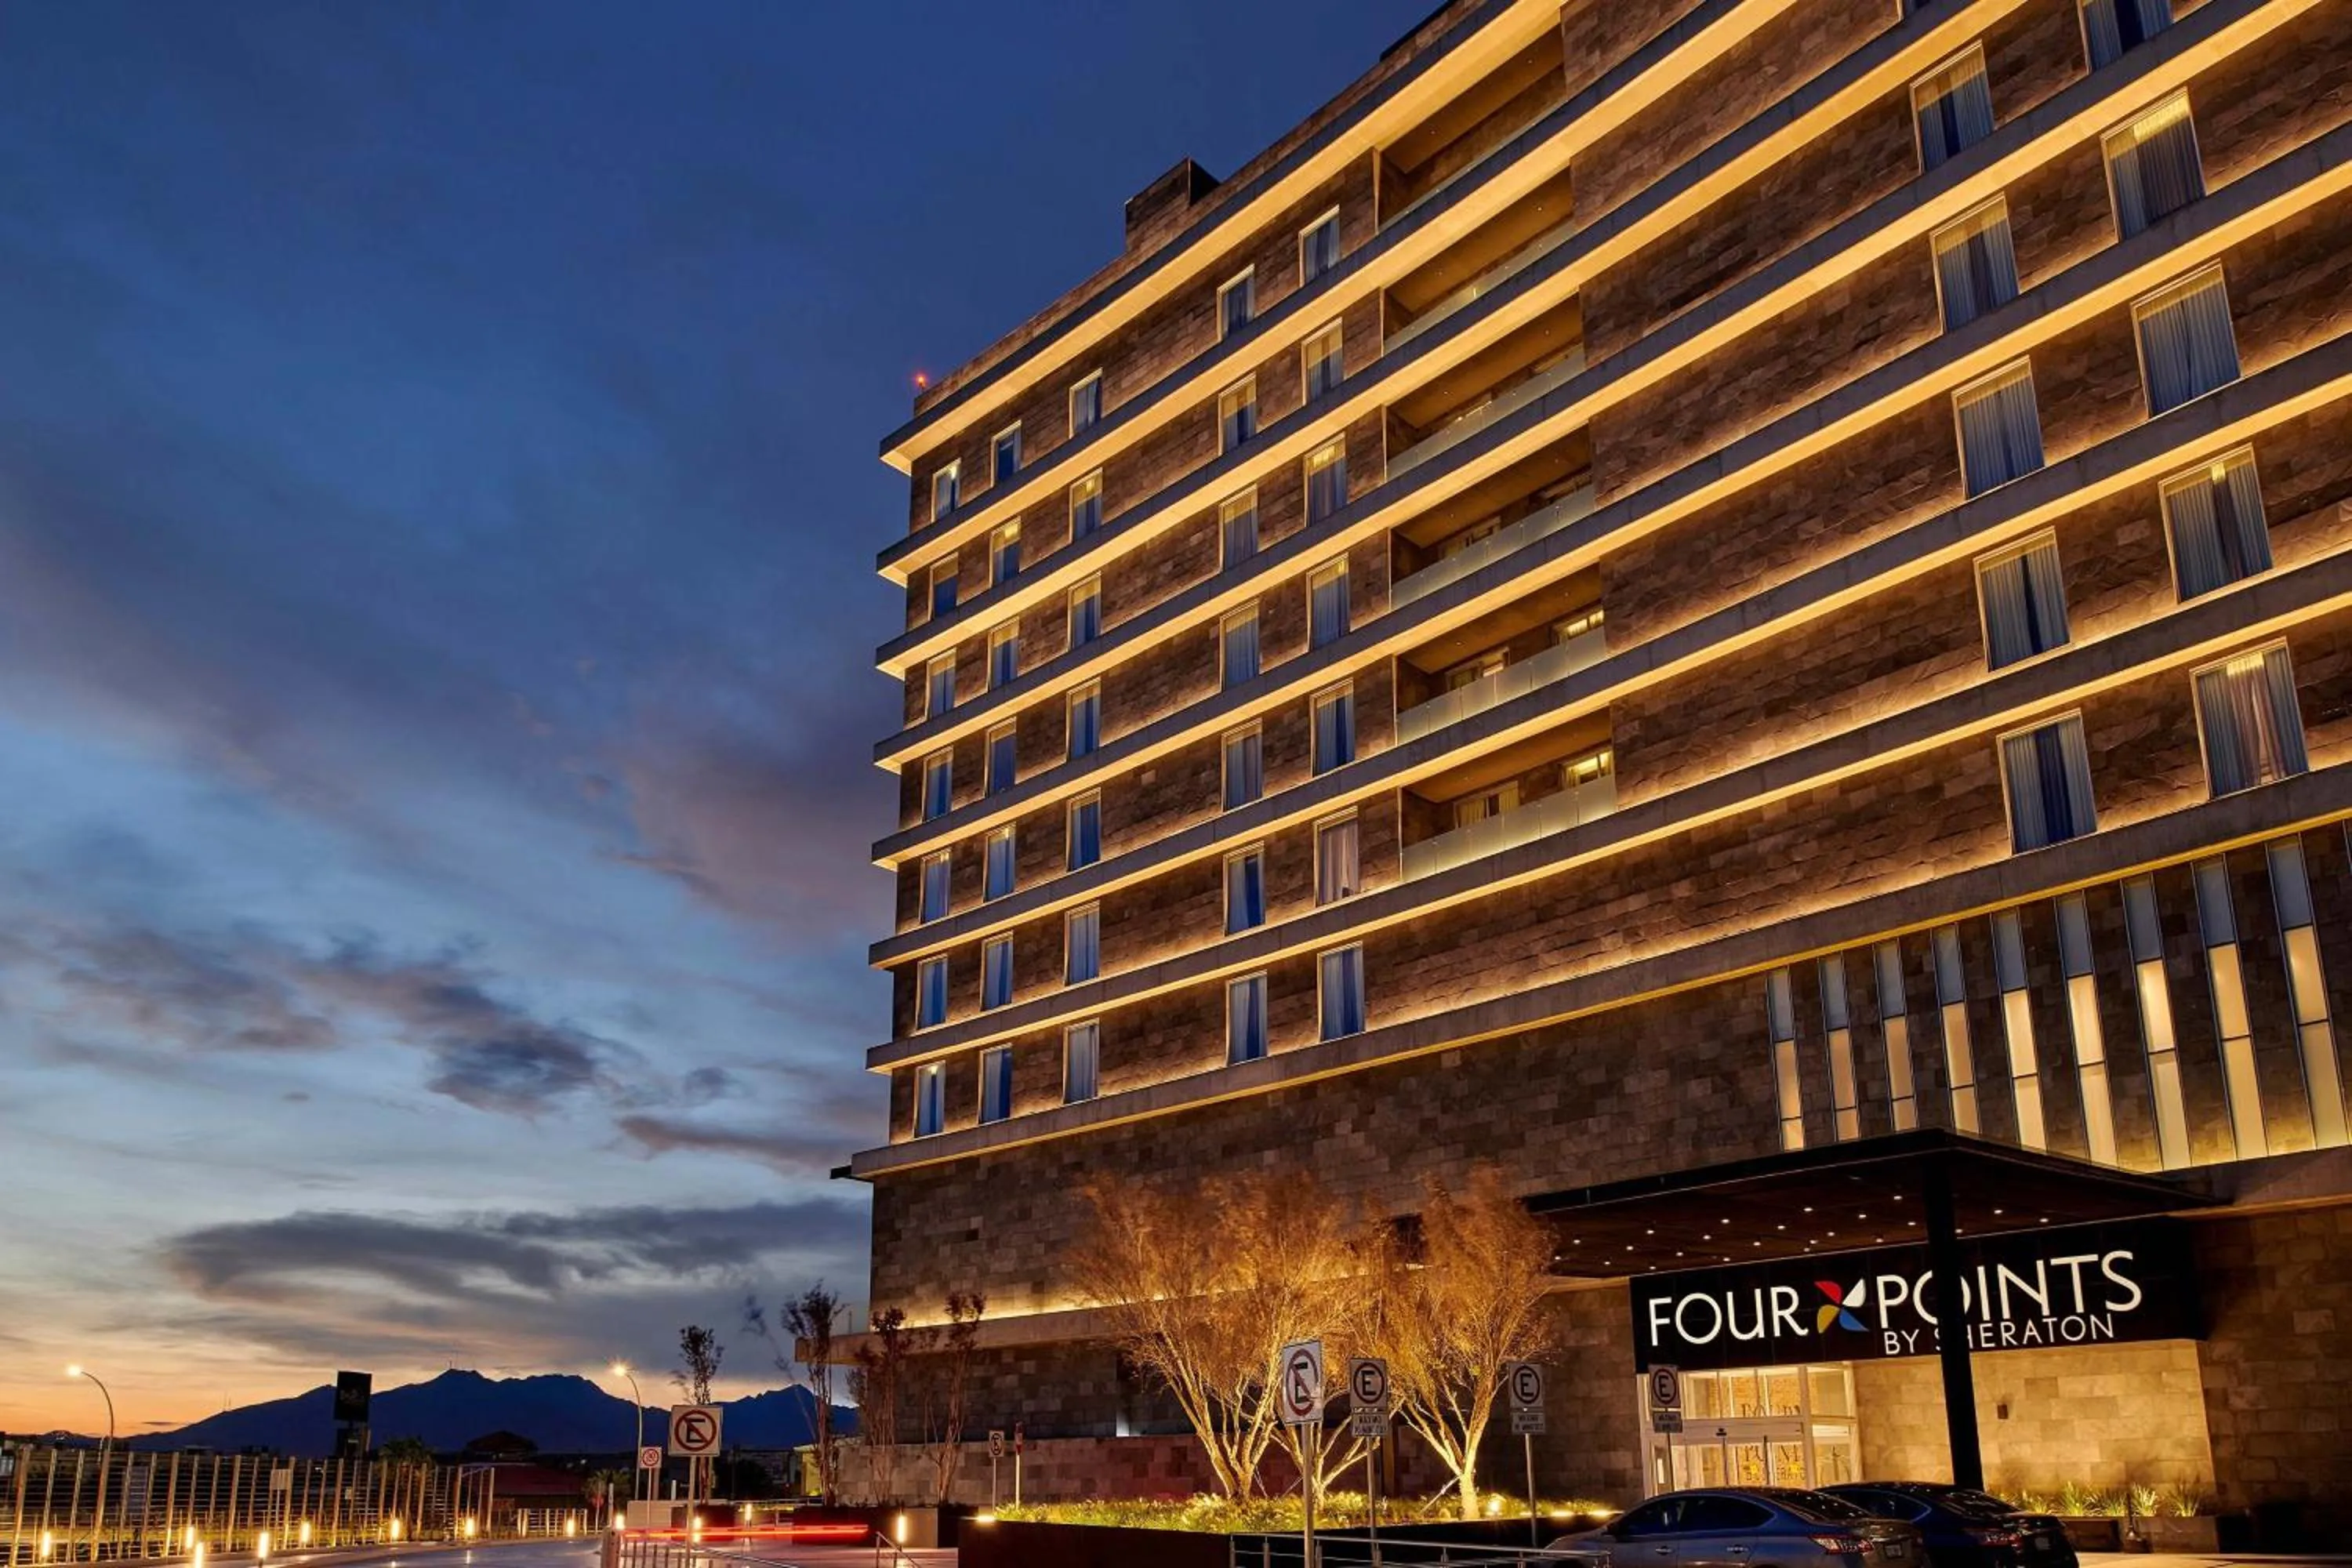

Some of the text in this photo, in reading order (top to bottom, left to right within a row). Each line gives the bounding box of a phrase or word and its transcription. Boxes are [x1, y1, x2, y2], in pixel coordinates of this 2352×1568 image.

[1649, 1285, 1809, 1347] FOUR
[1884, 1329, 1920, 1356] BY
[1361, 1370, 1377, 1396] E
[1520, 1373, 1534, 1397] E
[1659, 1374, 1671, 1398] E
